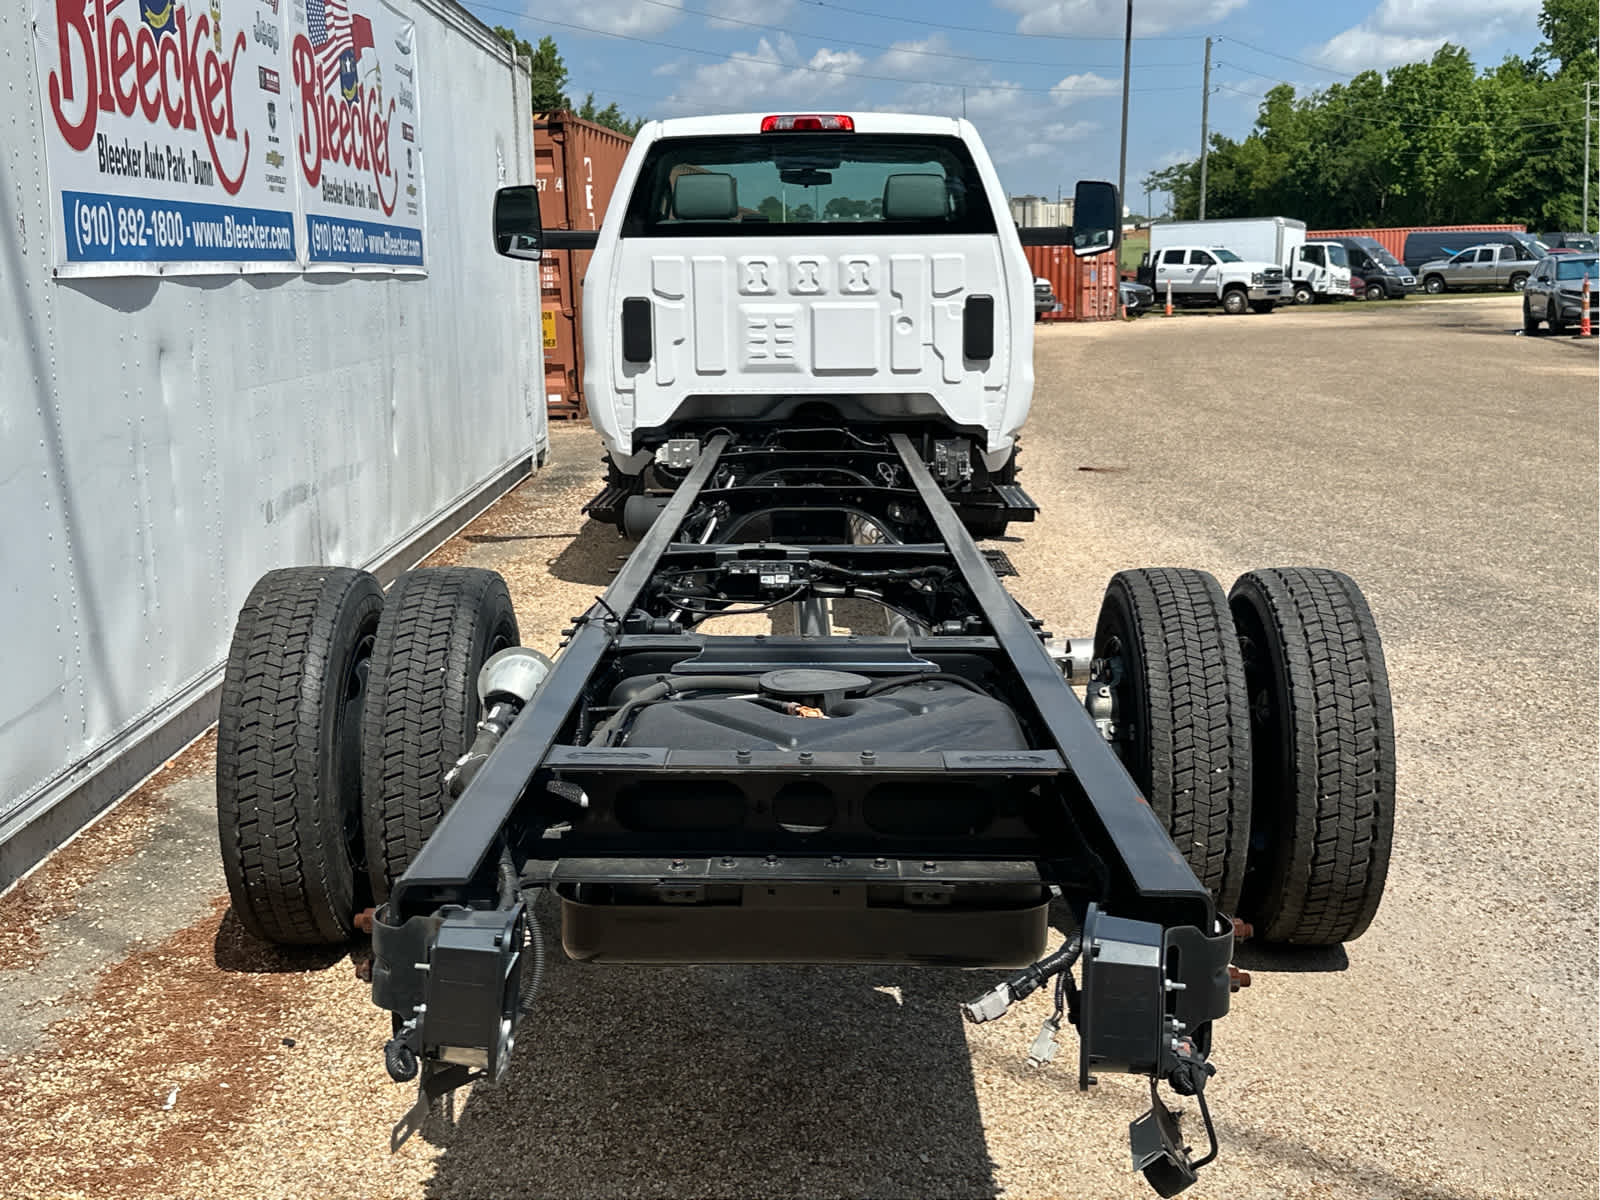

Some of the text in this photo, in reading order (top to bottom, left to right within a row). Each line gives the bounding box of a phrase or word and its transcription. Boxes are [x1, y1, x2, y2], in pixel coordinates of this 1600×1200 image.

[292, 33, 398, 217] Bleecker
[97, 132, 142, 178] Bleecker
[144, 140, 166, 181] Auto
[166, 145, 188, 184] Park
[192, 150, 214, 186] Dunn
[321, 174, 343, 205] Bleecker
[75, 199, 116, 255] (910)
[118, 207, 184, 248] 892-1800
[192, 215, 291, 250] www.Bleecker.com
[312, 220, 332, 257] (910)
[332, 224, 365, 253] 892-1800
